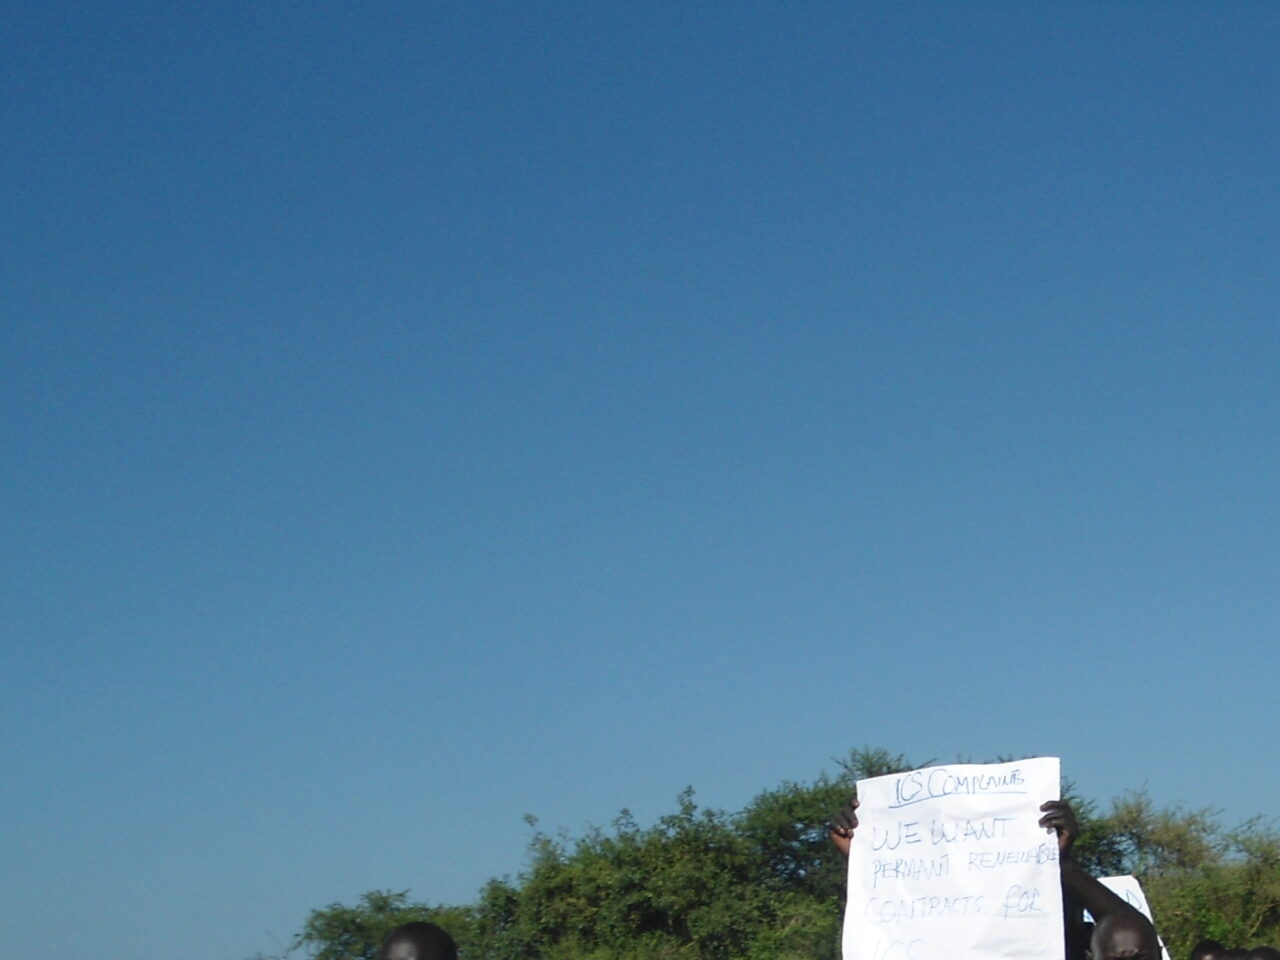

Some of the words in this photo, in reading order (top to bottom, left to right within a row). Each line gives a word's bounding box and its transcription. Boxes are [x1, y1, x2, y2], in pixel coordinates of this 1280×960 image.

[895, 771, 923, 804] ICS
[872, 821, 922, 851] WE
[931, 817, 1016, 846] WANT
[864, 895, 984, 926] CONTRACTS
